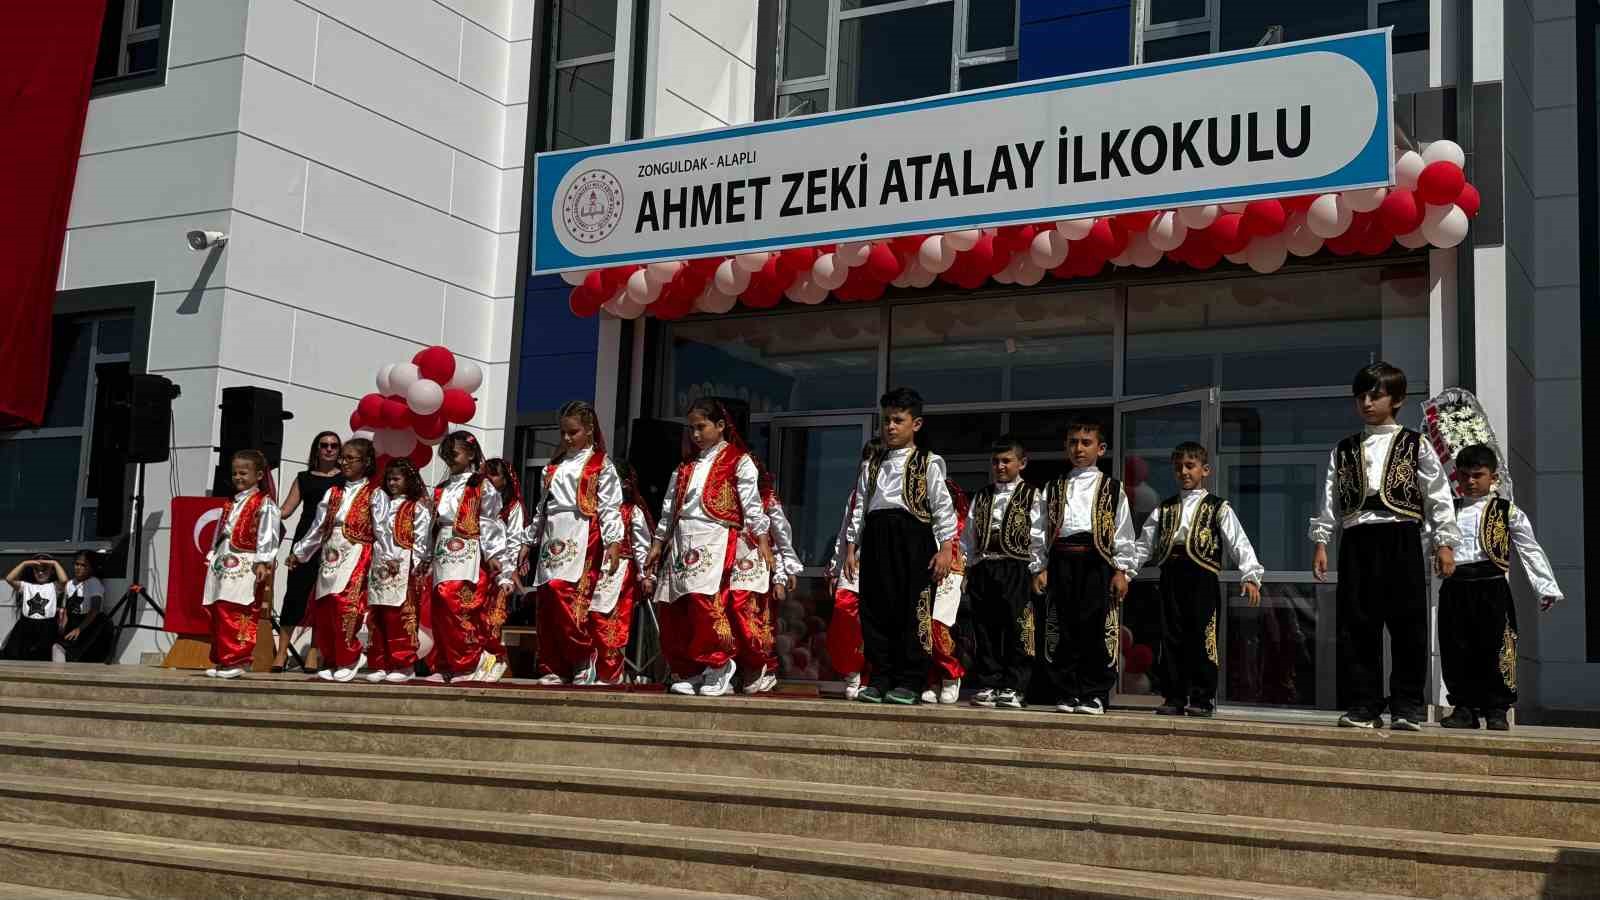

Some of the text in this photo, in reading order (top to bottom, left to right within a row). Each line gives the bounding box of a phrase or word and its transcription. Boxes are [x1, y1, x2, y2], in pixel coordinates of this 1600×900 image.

[634, 175, 771, 234] AHMET
[779, 152, 868, 218] ZEKİ
[880, 140, 1045, 206] ATALAY
[1058, 104, 1311, 185] İLKOKULU
[637, 157, 708, 178] ZONGULDAK
[716, 151, 757, 169] ALAPLI
